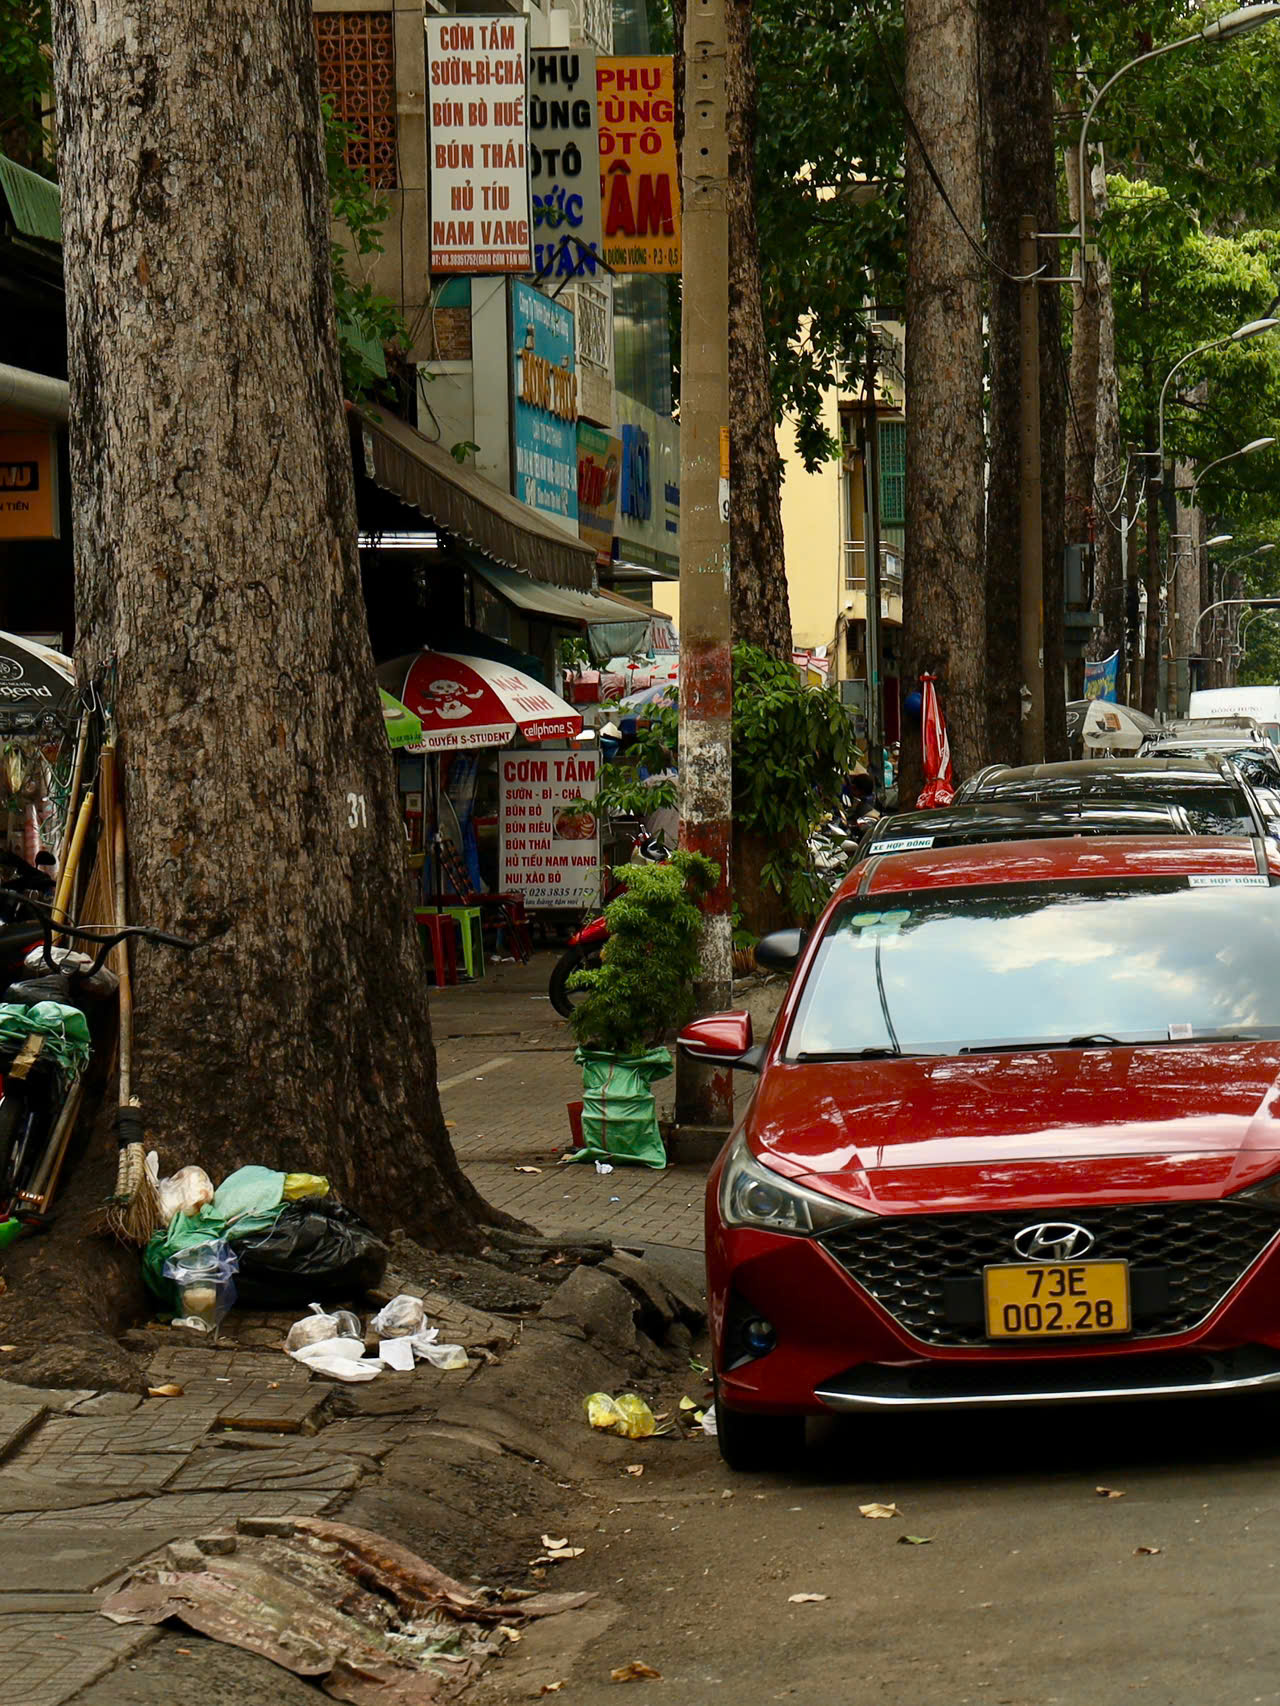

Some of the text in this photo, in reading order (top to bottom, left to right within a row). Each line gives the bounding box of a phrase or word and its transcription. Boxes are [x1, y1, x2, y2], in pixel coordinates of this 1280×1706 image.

[440, 18, 515, 50] CƠM TẤM
[431, 53, 525, 86] SƯỜN-BÌ-CHẢ
[596, 68, 661, 98] PHỤ
[433, 95, 524, 127] BÚN BÒ HUẾ
[530, 94, 591, 129] ÙNG
[598, 95, 673, 123] ÙNG
[435, 139, 525, 169] BÚN THÁI
[599, 126, 663, 155] ÔTÔ
[451, 180, 510, 211] HỦ TÍU
[600, 159, 675, 237] ÂM
[433, 221, 528, 246] NAM VANG
[534, 235, 597, 276] UÂN
[461, 731, 511, 745] S-STUDENT
[524, 723, 565, 739] cellphone
[503, 752, 596, 783] CƠM TẤM
[505, 786, 533, 800] SƯỜN
[542, 786, 552, 800] BÌ
[562, 785, 582, 800] CHẢ
[347, 792, 367, 829] 31
[505, 804, 542, 817] BÚN BÒ
[505, 820, 551, 833] BÚN RIÊU
[505, 837, 551, 850] BÚN THÁI
[505, 853, 519, 867] HỦ
[545, 855, 568, 867] NAM
[571, 855, 597, 867] VANG
[505, 870, 561, 884] NUI XÀO BÒ
[1026, 1267, 1087, 1298] 73E
[1003, 1300, 1113, 1332] 002.28
